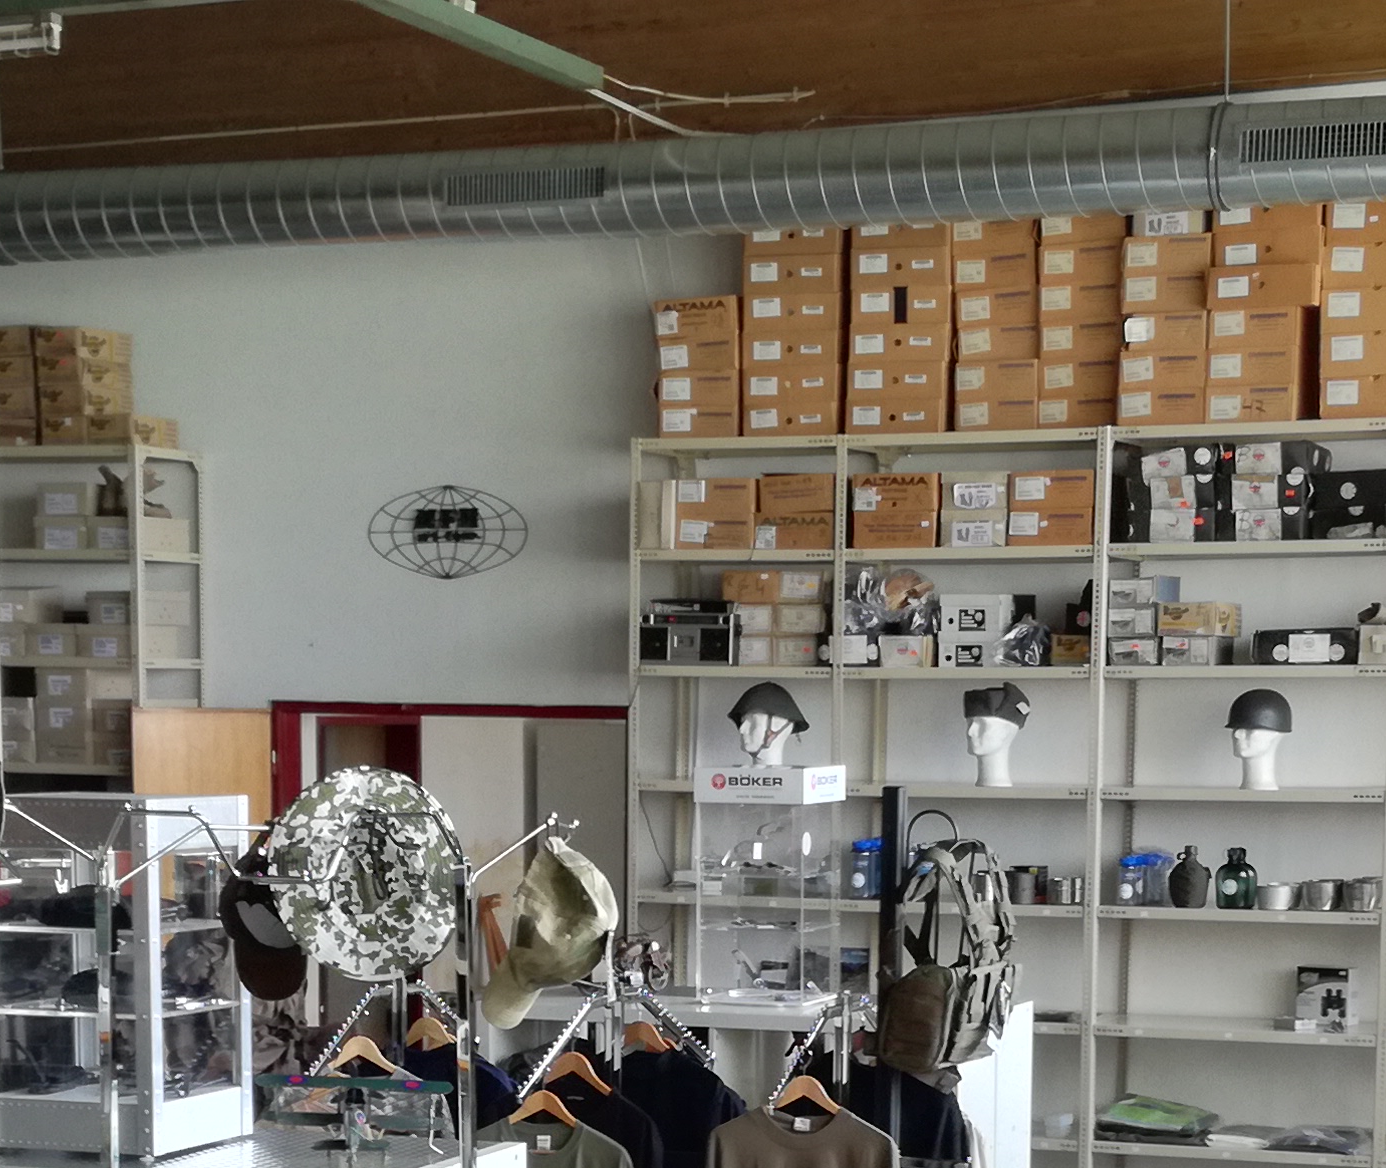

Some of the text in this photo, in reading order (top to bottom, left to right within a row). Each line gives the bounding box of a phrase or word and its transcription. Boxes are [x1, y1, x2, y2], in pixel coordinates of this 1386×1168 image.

[662, 299, 727, 313] ALTAMA
[862, 476, 928, 487] ALTAMA
[761, 516, 829, 527] ALTAMA
[728, 774, 783, 786] BÖKER
